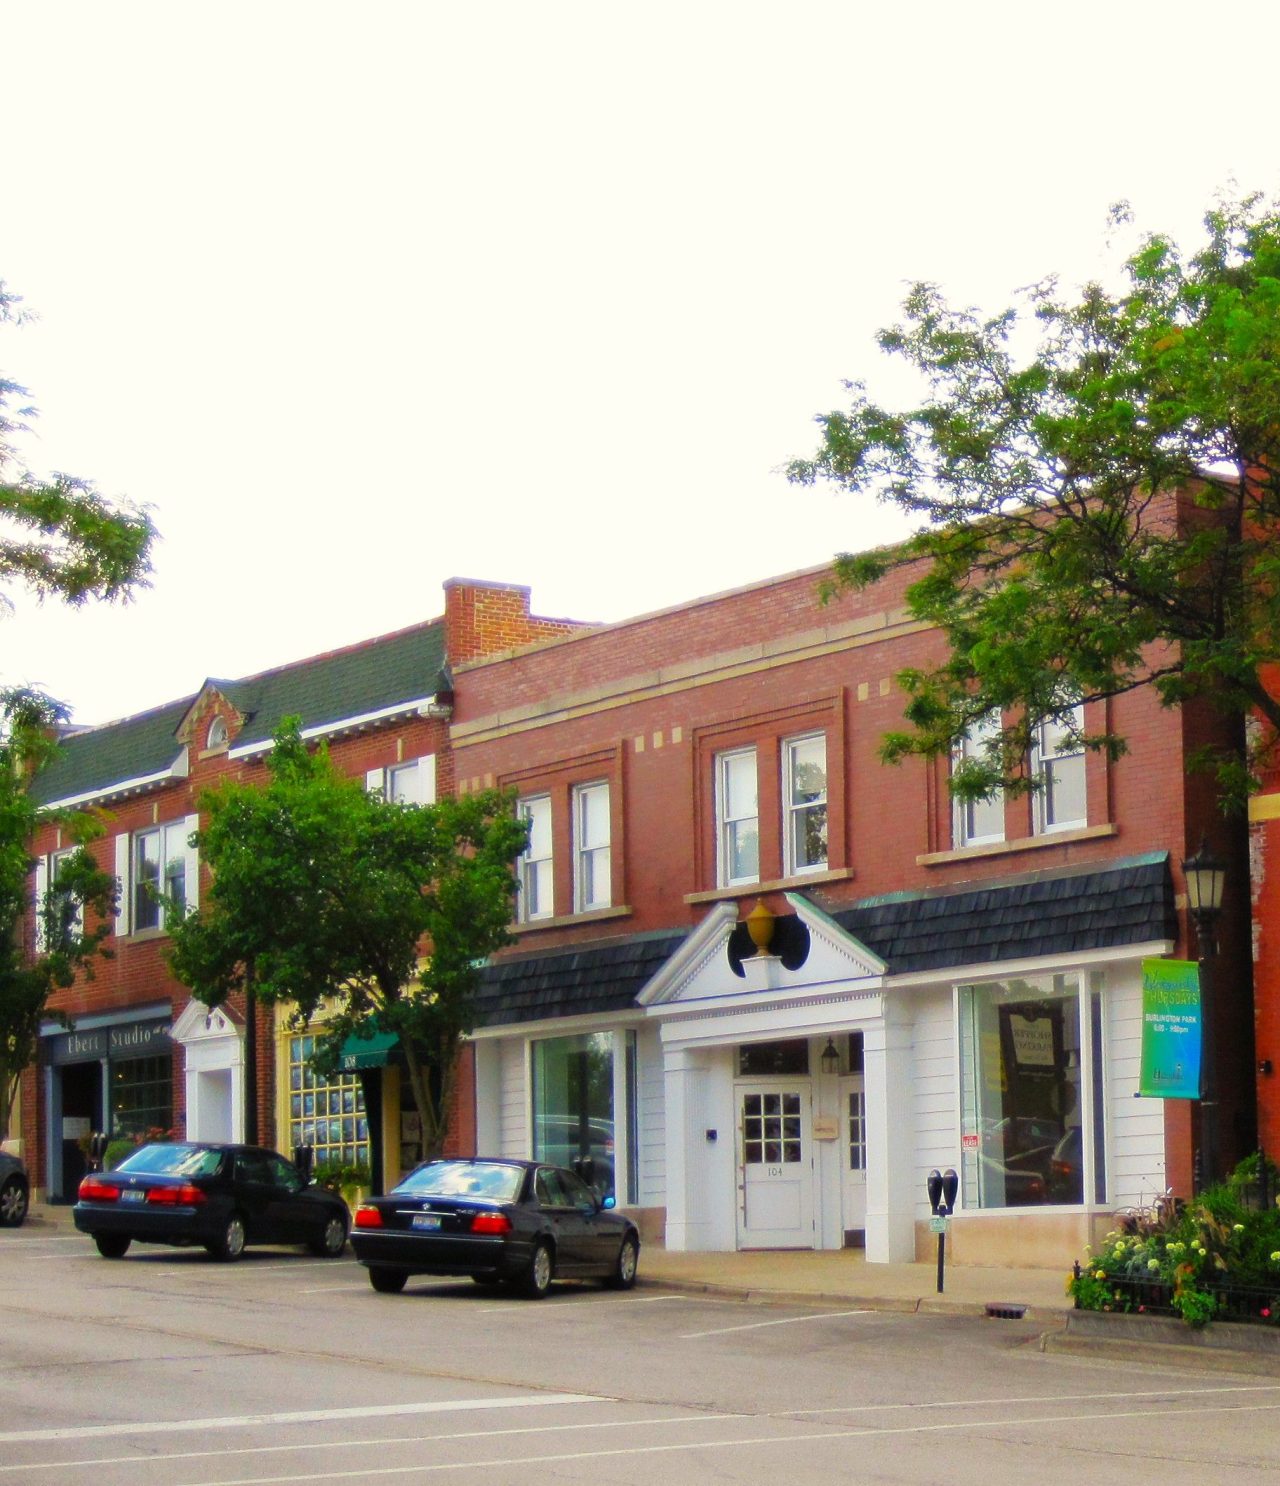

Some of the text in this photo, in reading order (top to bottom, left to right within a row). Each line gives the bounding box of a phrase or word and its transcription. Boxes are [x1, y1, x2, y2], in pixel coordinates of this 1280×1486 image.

[1144, 989, 1198, 1005] THURSDAYS
[1145, 1013, 1197, 1024] BURLINGTON PARK
[67, 1034, 99, 1054] Ebert
[111, 1025, 151, 1047] Studio
[768, 1168, 782, 1176] 104
